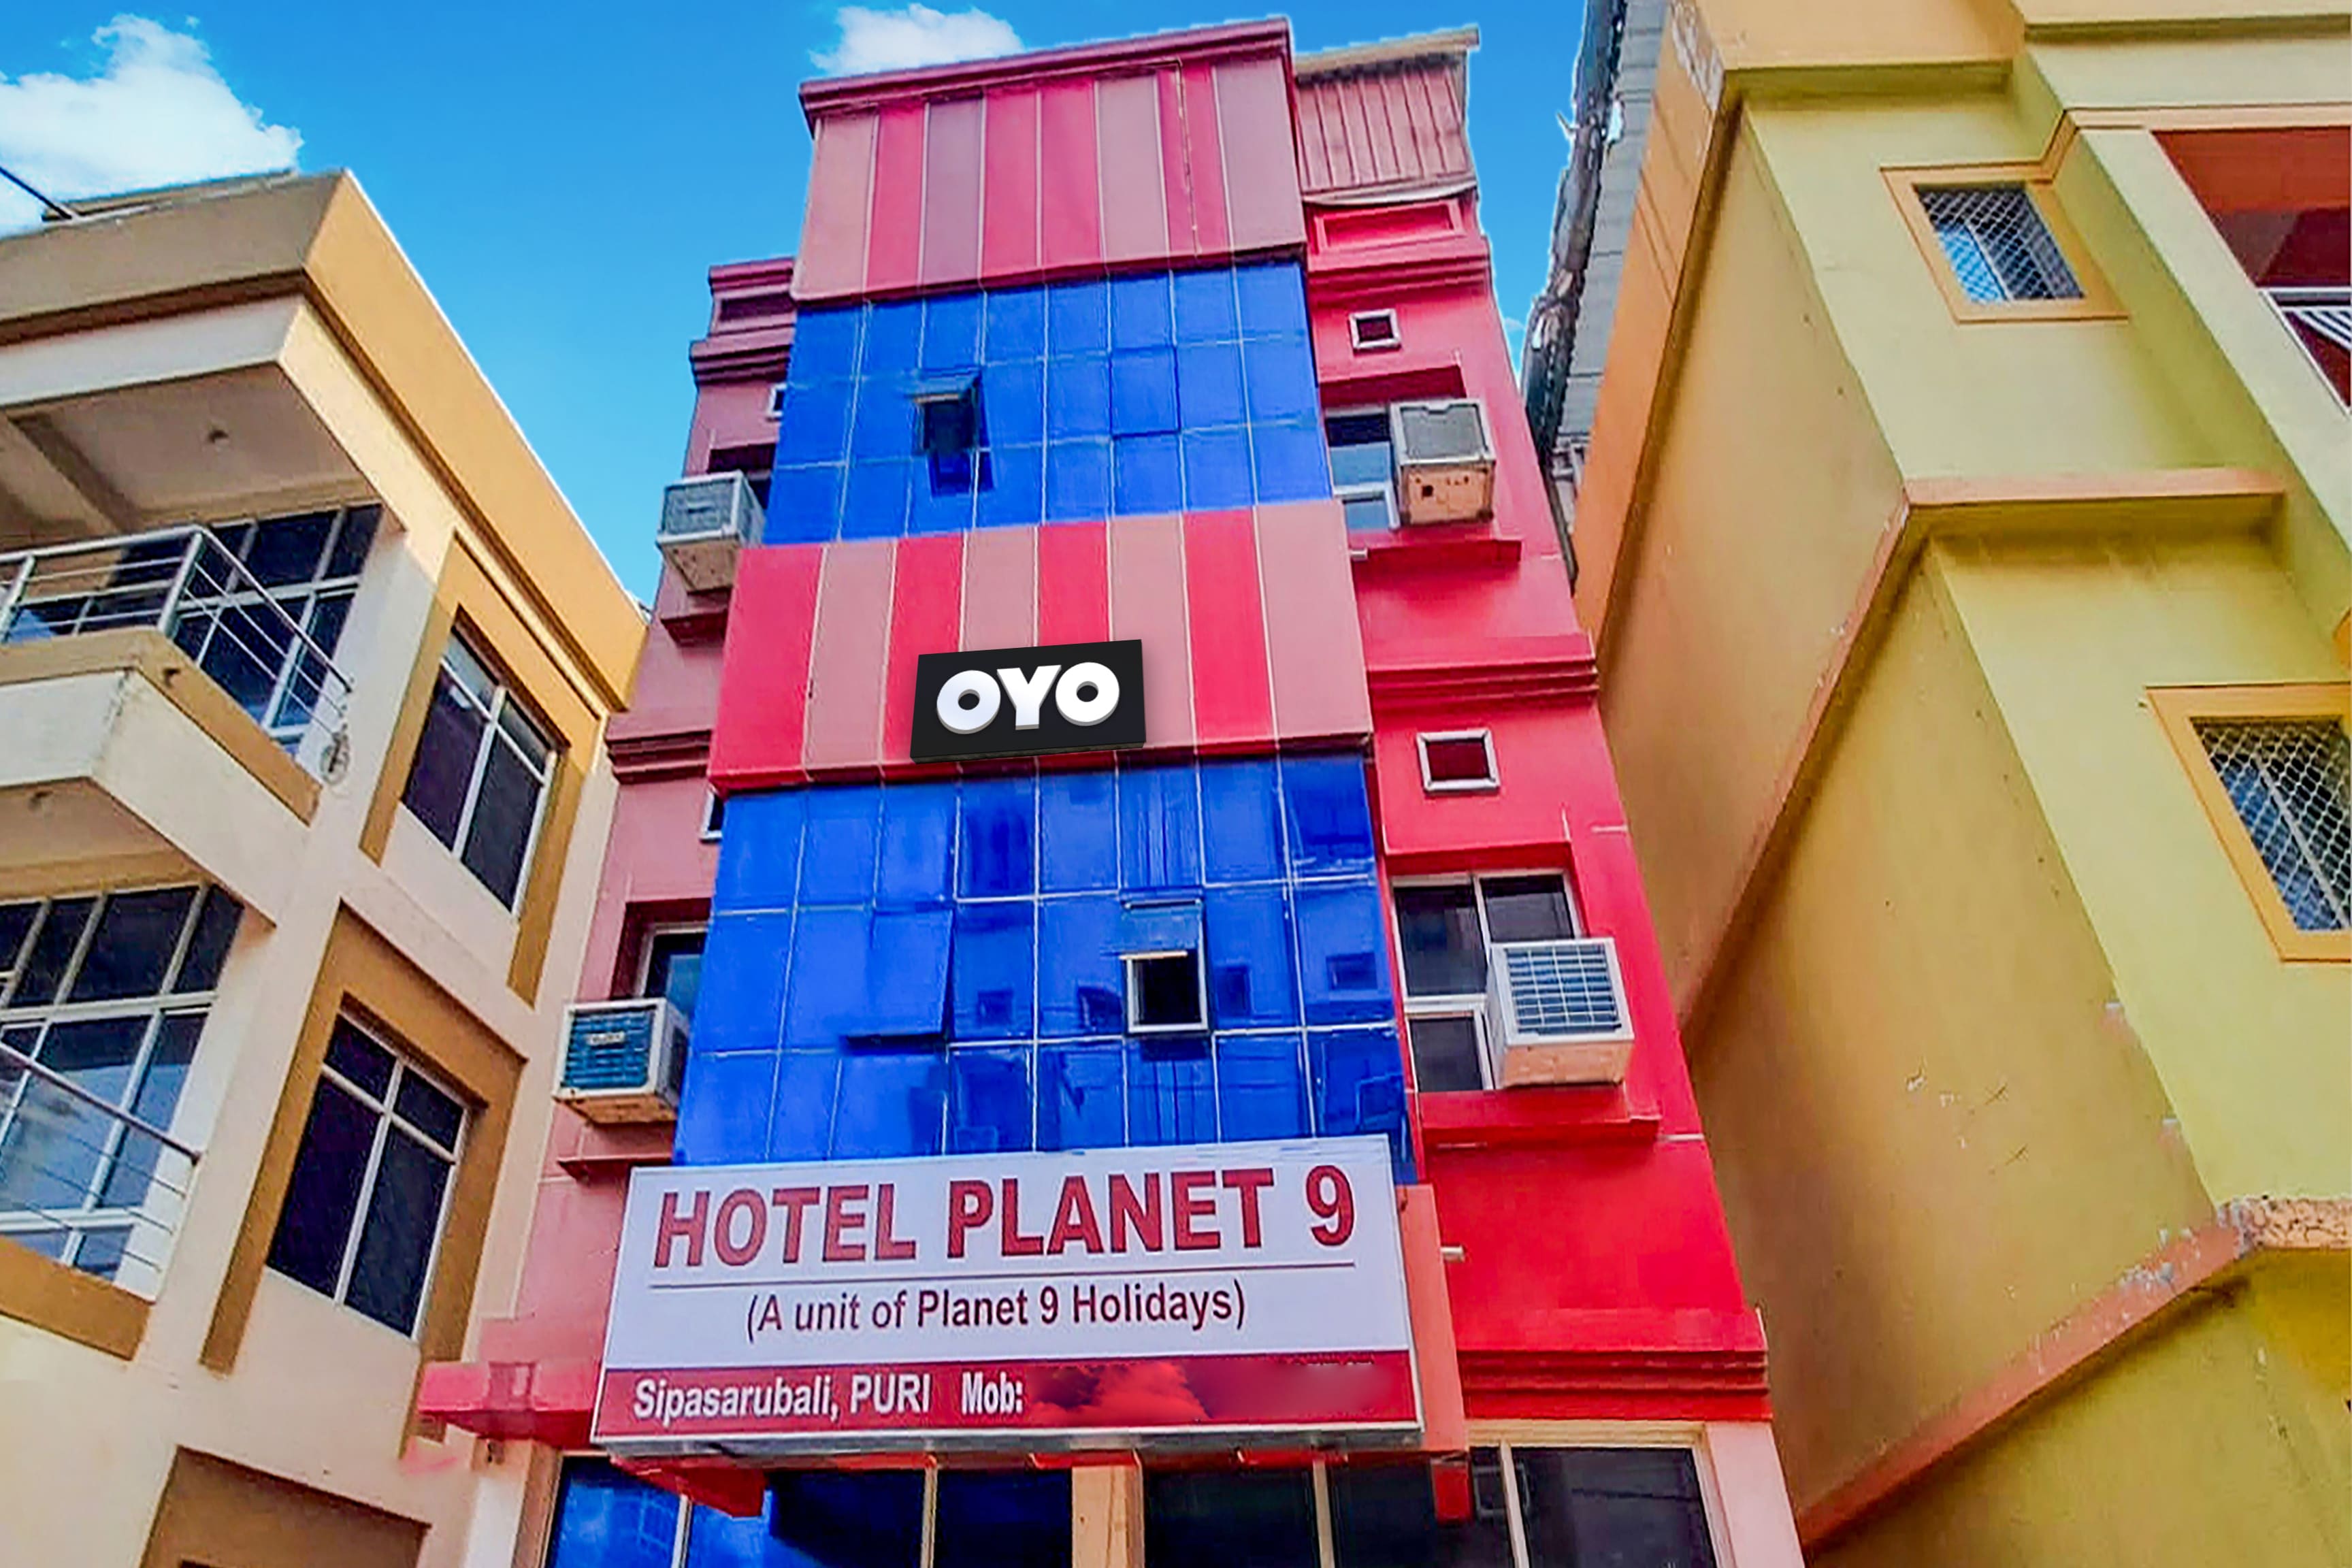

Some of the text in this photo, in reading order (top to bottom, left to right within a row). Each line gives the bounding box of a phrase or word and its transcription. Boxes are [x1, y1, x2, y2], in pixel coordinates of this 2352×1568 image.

[936, 662, 1120, 734] OYO
[654, 1164, 1355, 1267] HOTEL PLANET 9
[747, 1279, 1245, 1343] (A unit of Planet 9 Holidays)
[634, 1371, 1023, 1426] Sipasarubali, PURI Mob:
